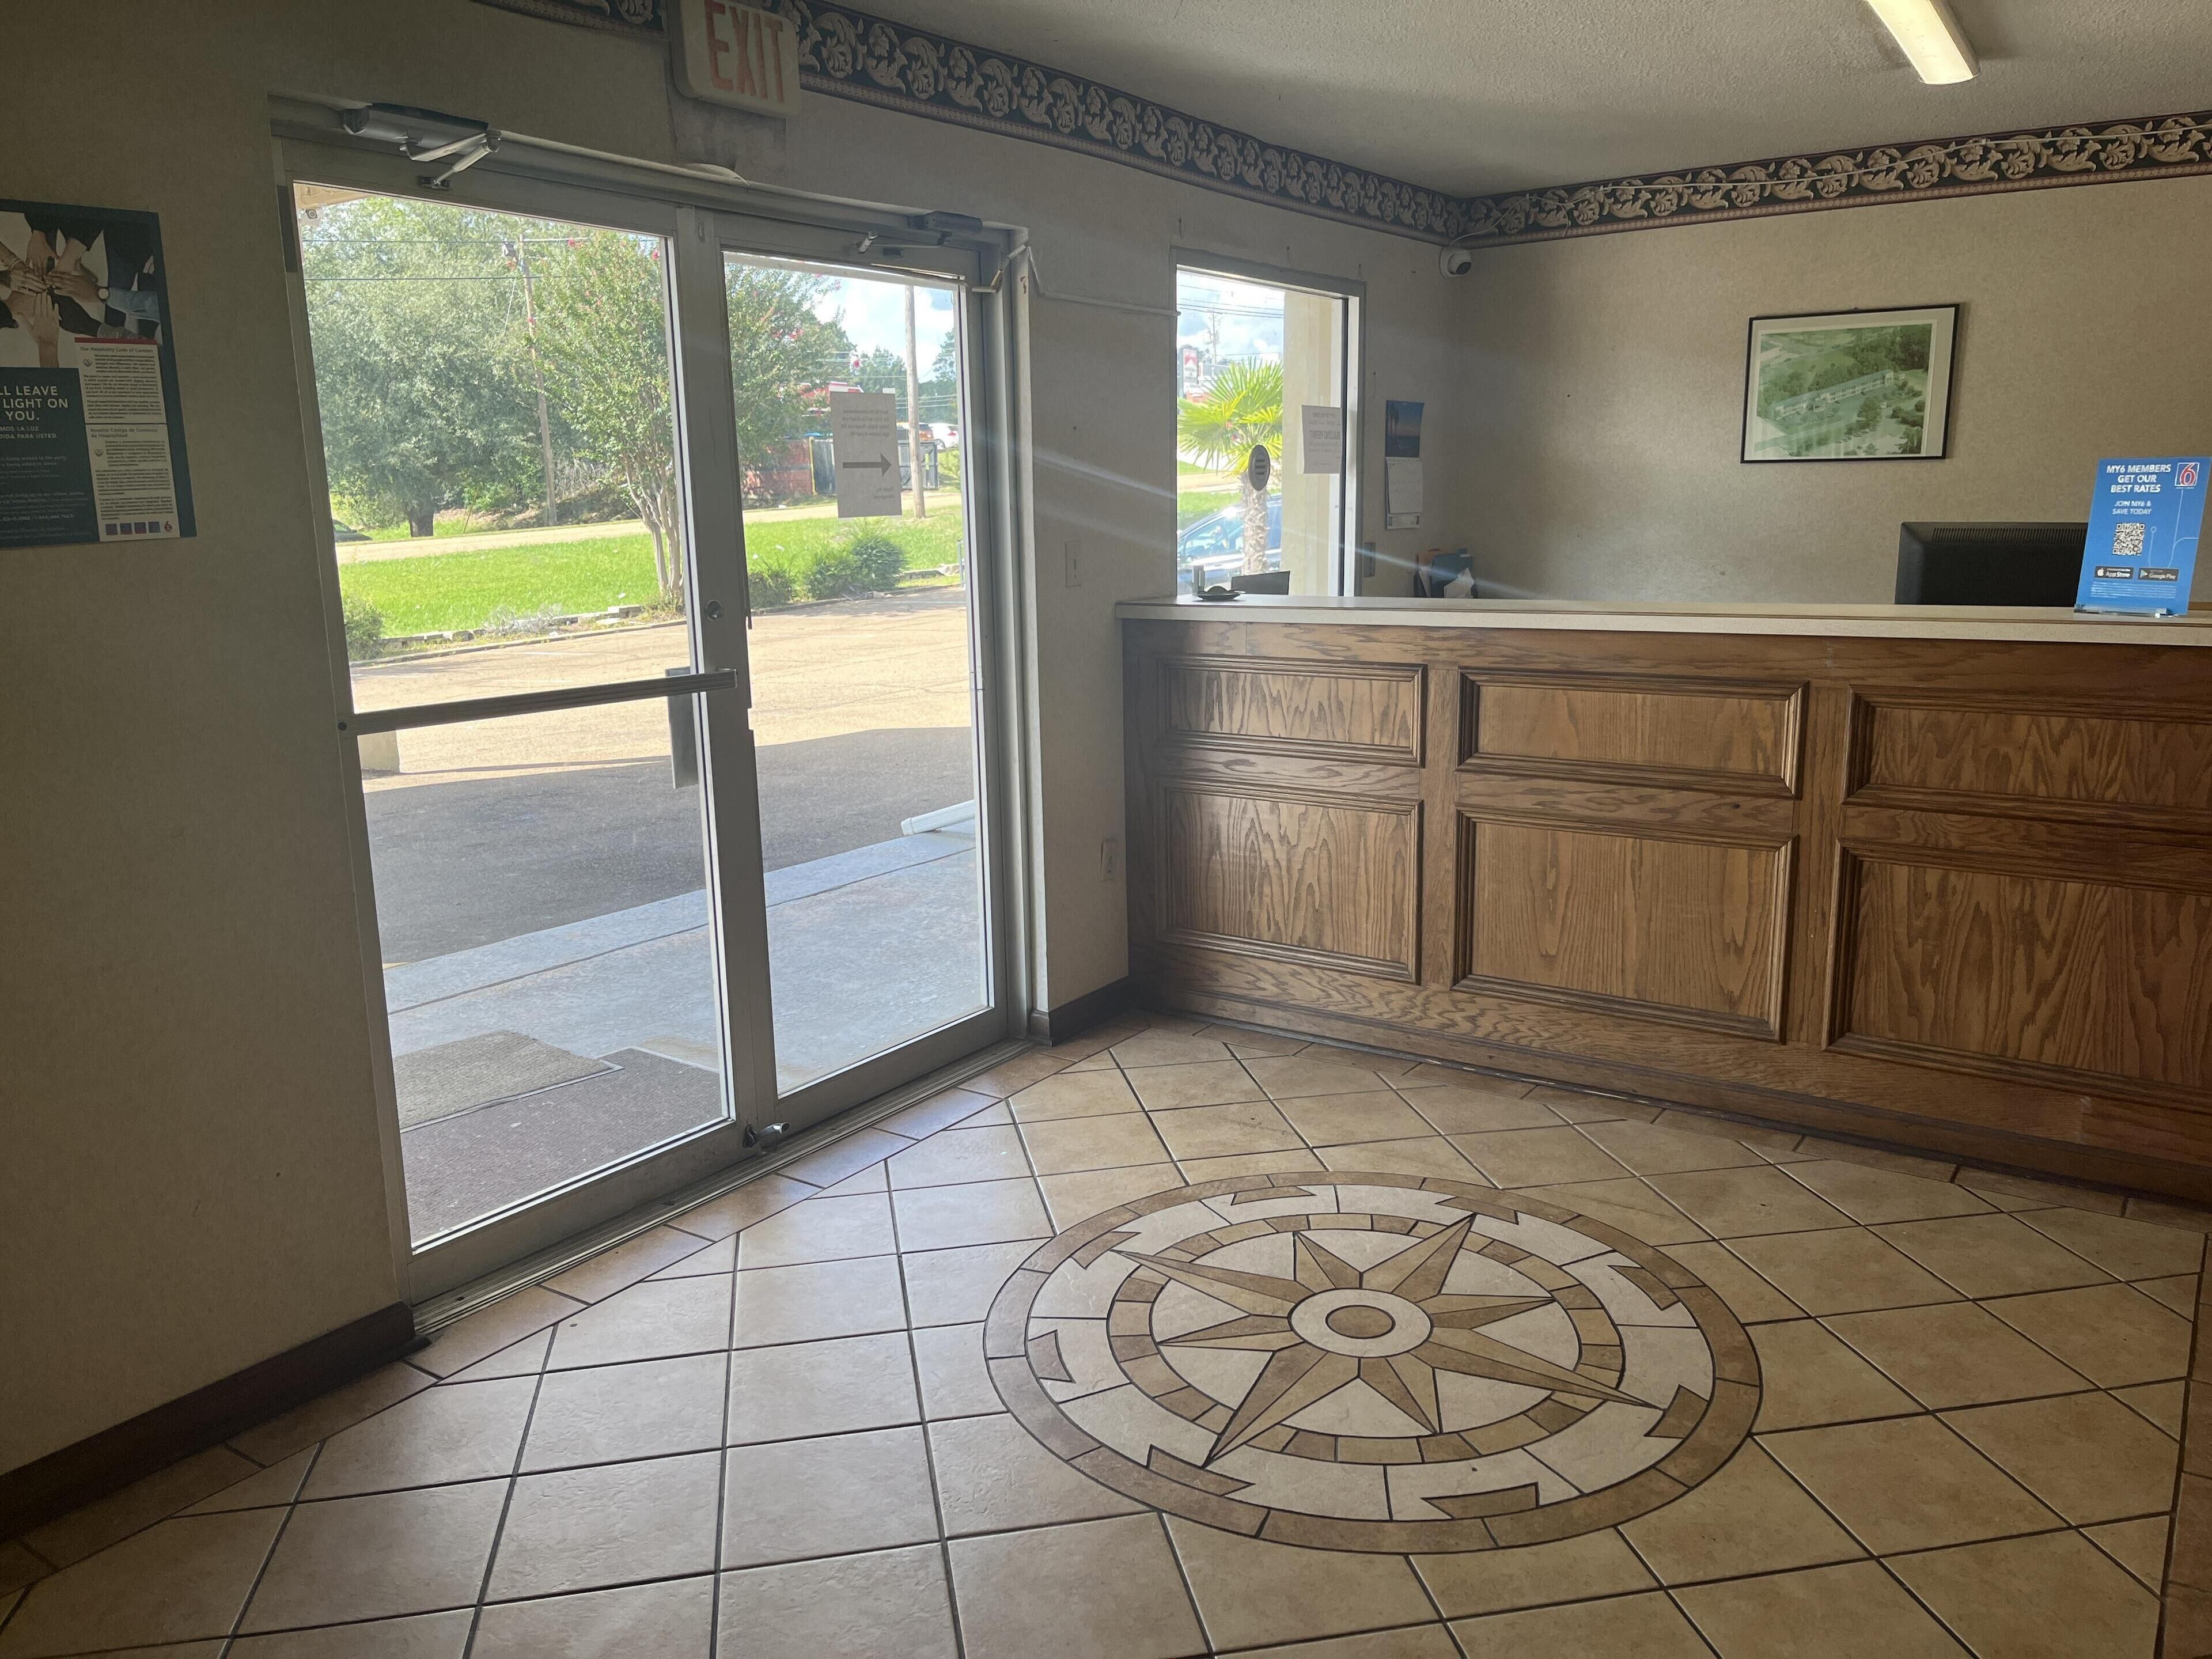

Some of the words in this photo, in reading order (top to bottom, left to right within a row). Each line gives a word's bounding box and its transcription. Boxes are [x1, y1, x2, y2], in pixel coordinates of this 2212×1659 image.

[704, 0, 785, 104] EXIT
[16, 385, 58, 396] LEAVE
[3, 398, 42, 408] LIGHT
[47, 398, 69, 408] ON
[5, 411, 40, 421] YOU.
[2106, 465, 2126, 473] MY6
[2127, 464, 2172, 472] MEMBERS
[2117, 475, 2135, 483] GET
[2137, 474, 2157, 483] OUR
[2110, 484, 2133, 493] BEST
[2134, 484, 2161, 493] RATES
